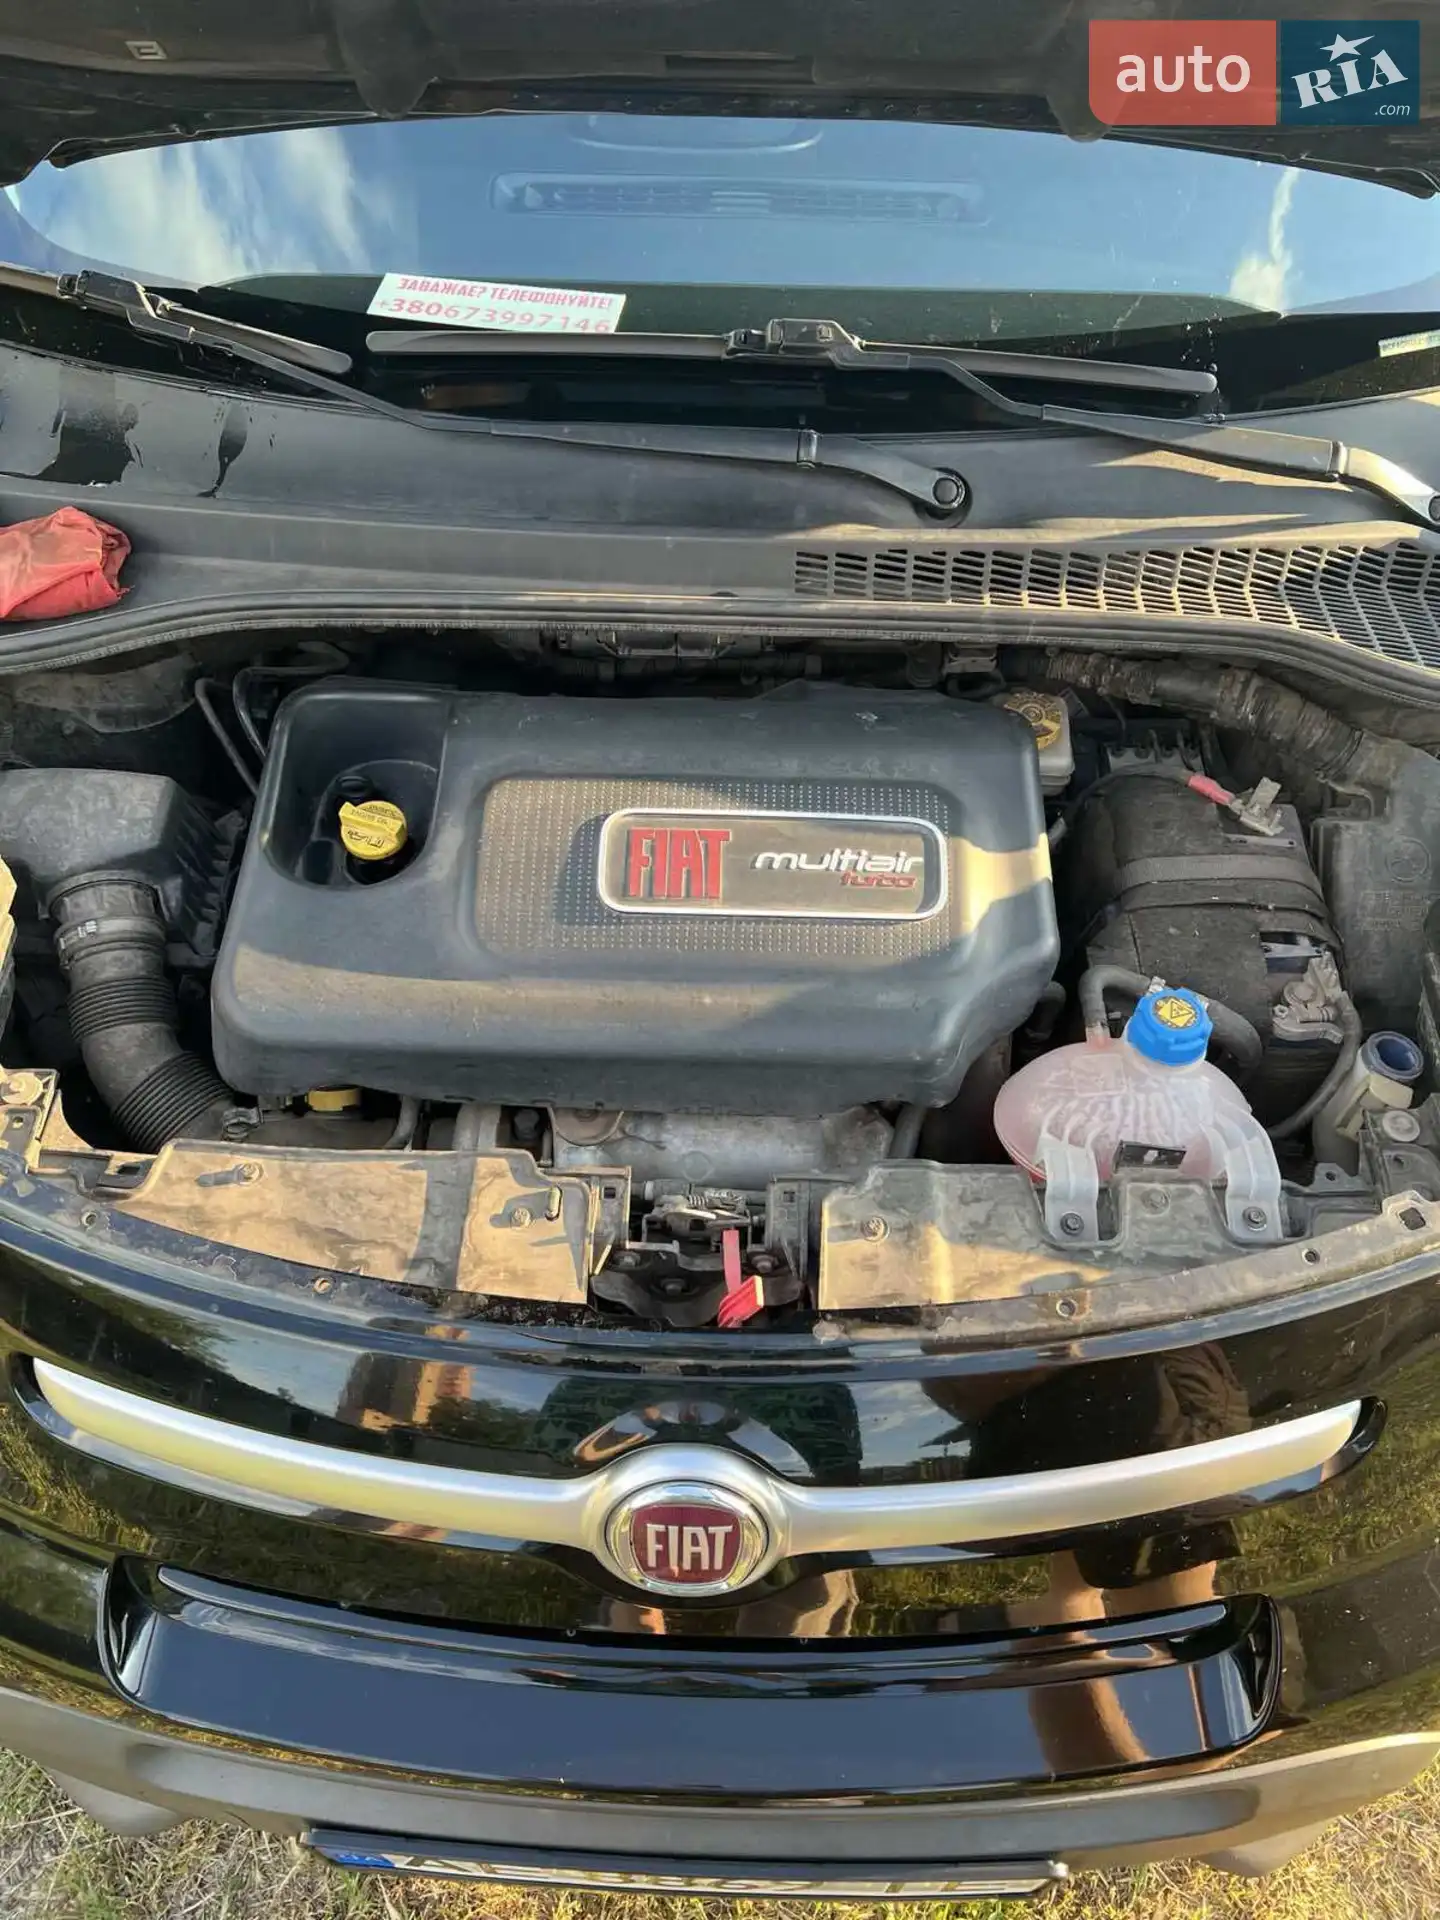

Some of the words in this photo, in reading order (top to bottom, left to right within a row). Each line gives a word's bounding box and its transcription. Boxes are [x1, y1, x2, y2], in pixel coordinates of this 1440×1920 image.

[396, 277, 487, 299] ЗАВАЖАЕ?
[375, 298, 611, 333] +380673997146
[627, 827, 731, 900] FIAT
[754, 848, 924, 874] multiair
[841, 872, 918, 889] turbo
[646, 1523, 733, 1571] FIAT
